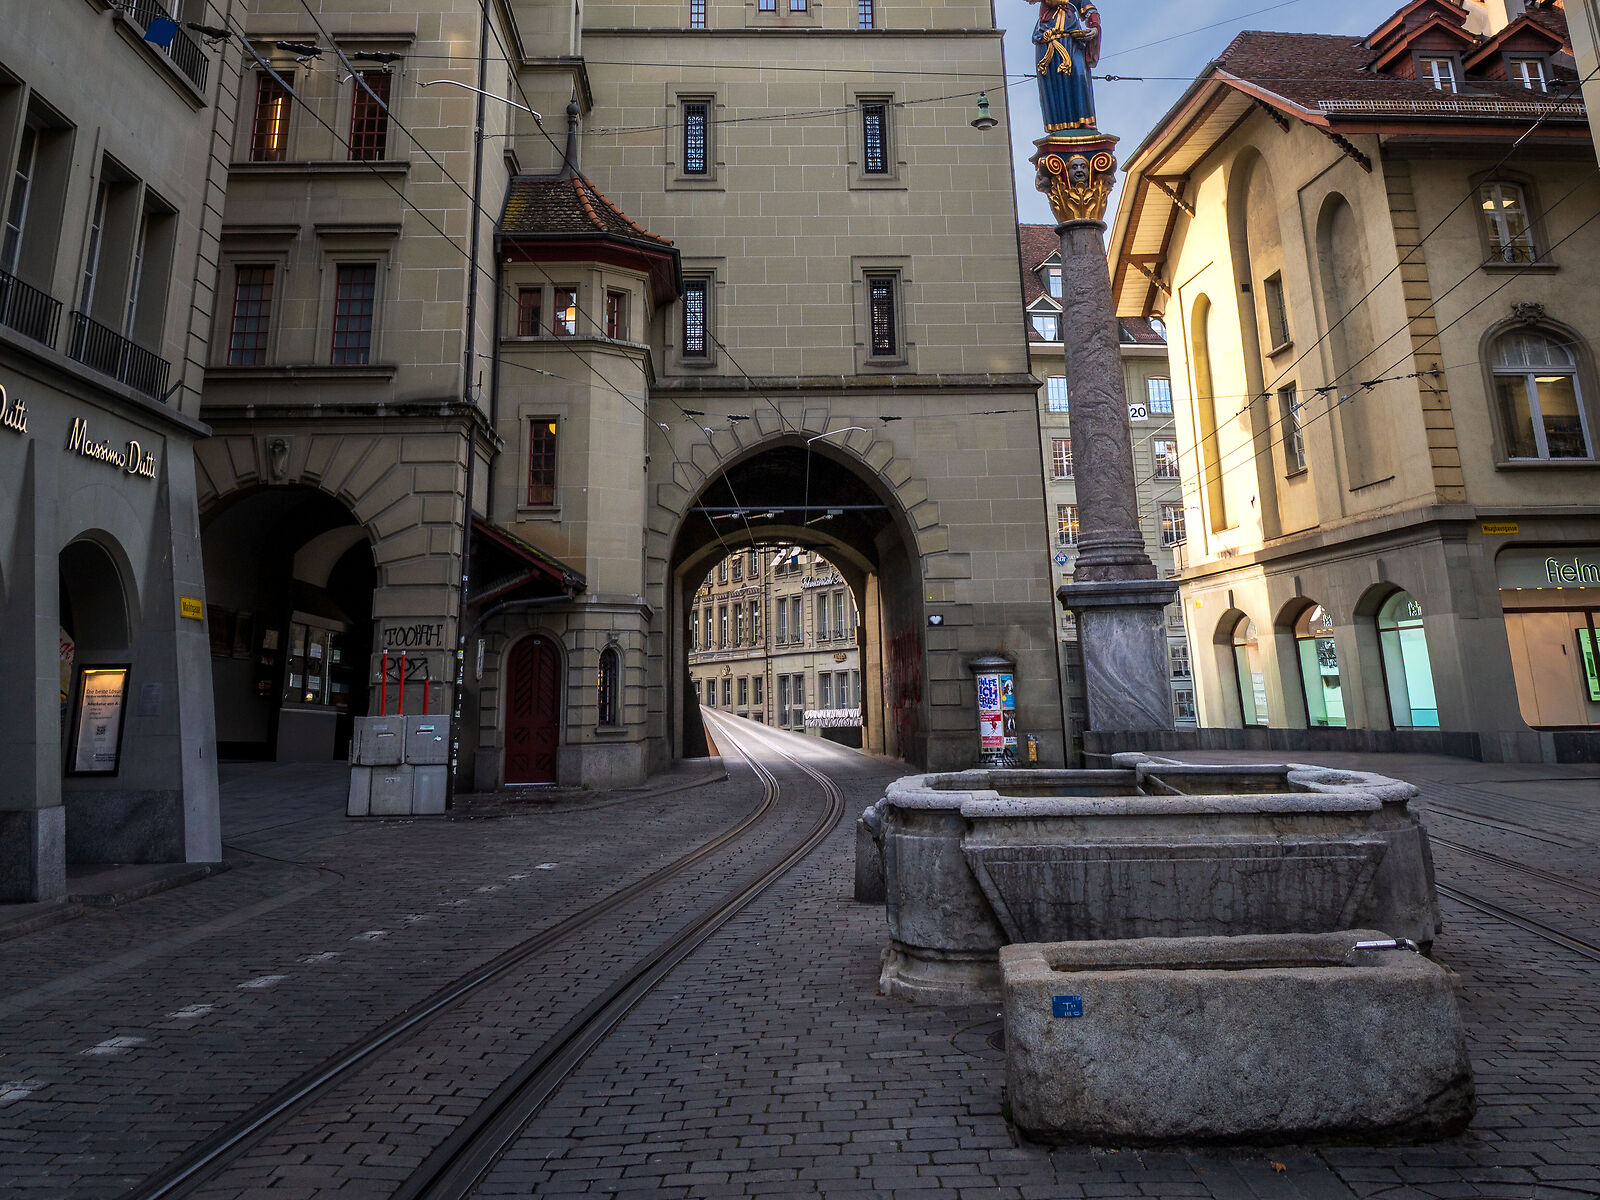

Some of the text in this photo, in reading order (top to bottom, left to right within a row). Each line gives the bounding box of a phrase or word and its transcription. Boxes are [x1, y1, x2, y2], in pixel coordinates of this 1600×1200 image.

[1130, 407, 1146, 417] 20
[69, 417, 156, 478] Massimo Dutti
[1545, 557, 1600, 583] fielm
